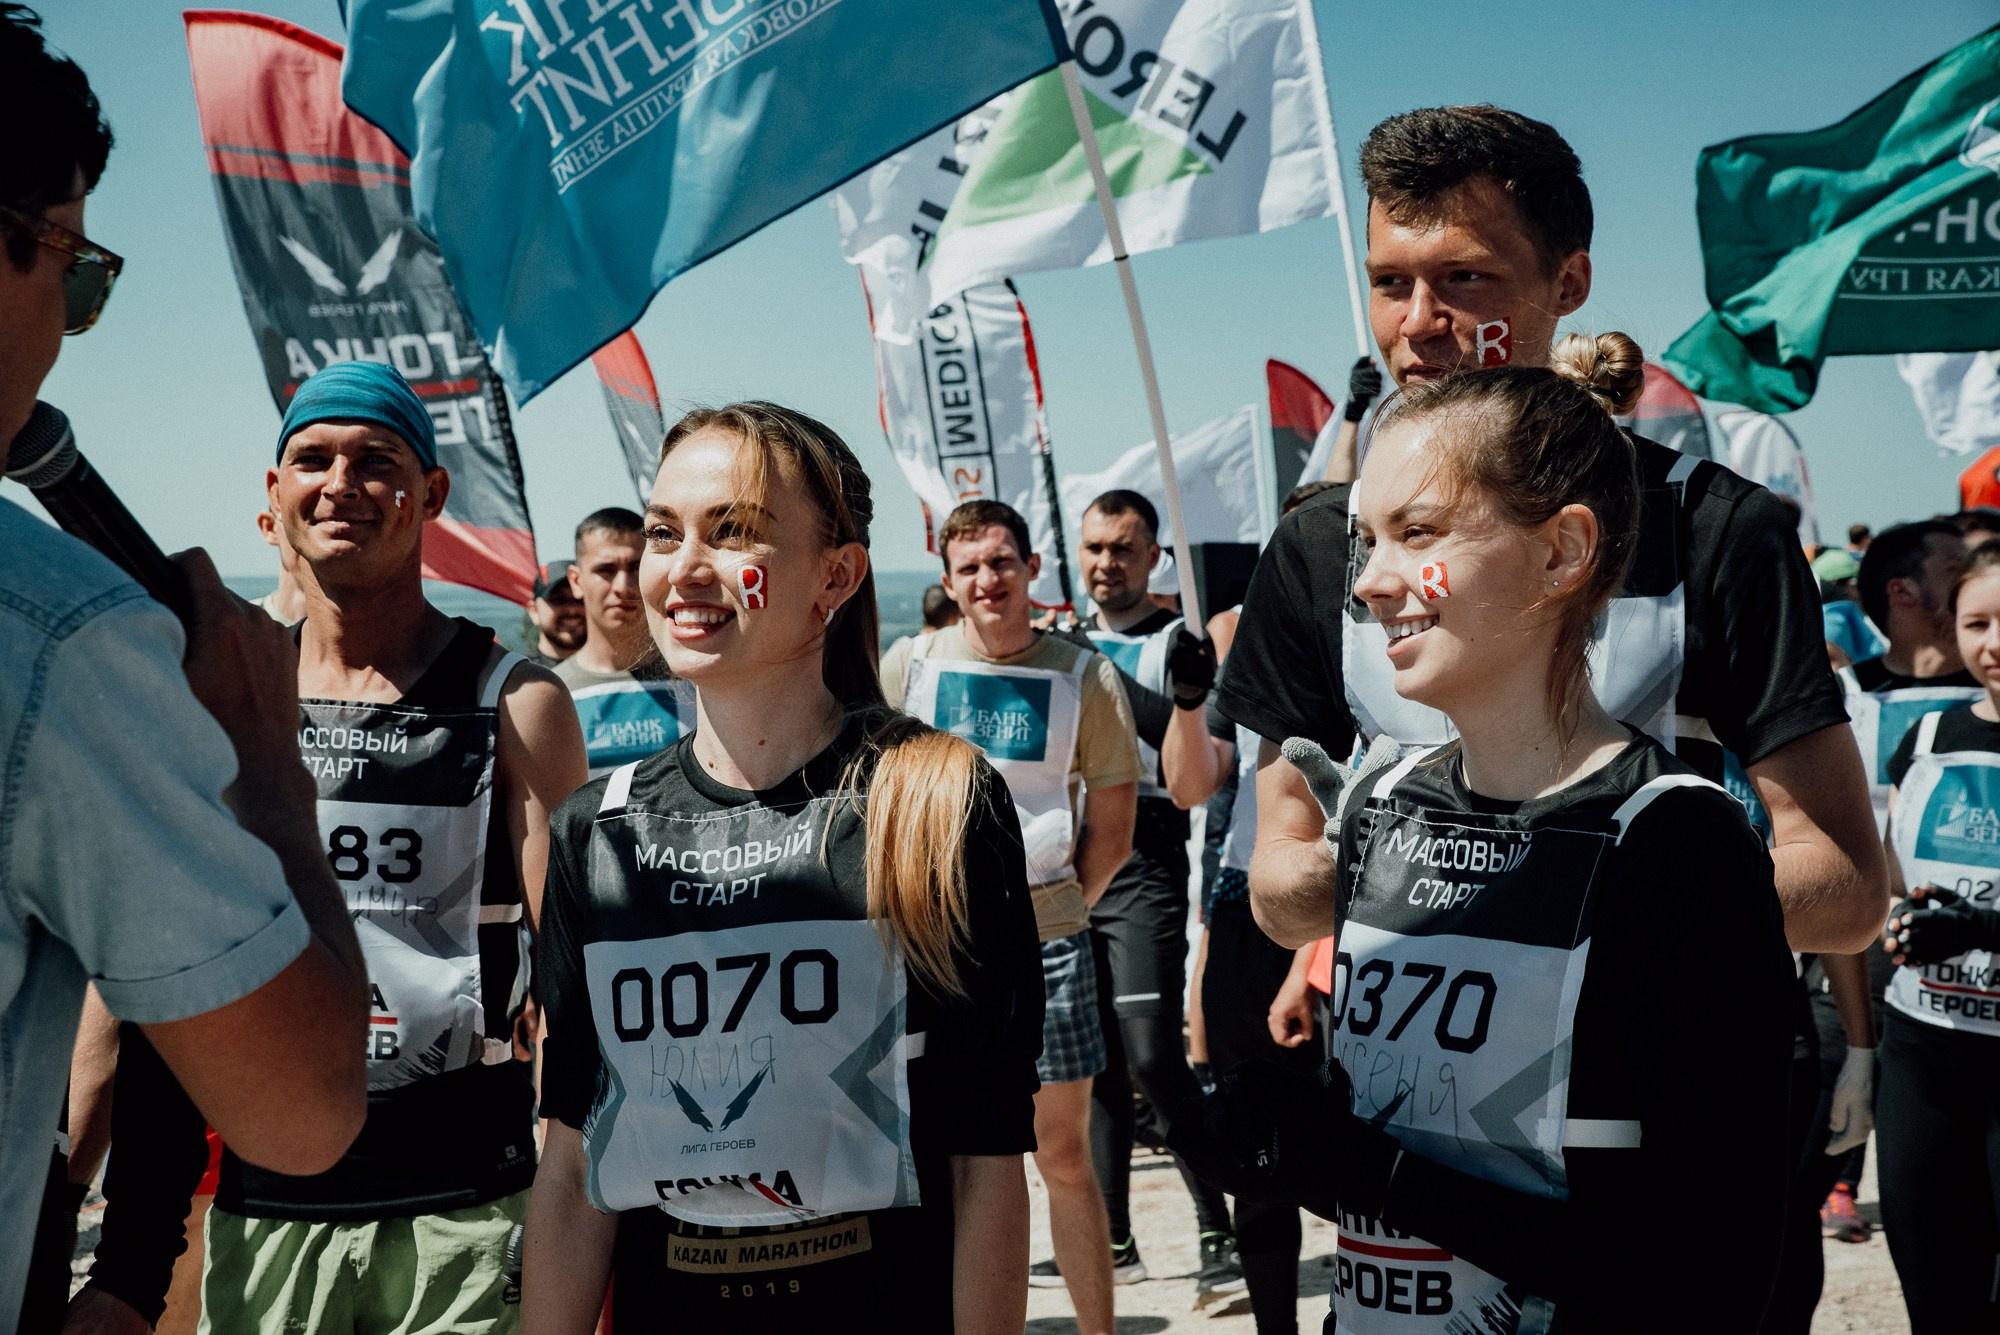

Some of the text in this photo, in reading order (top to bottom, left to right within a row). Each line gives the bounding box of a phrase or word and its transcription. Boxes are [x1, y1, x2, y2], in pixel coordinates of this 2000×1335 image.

[976, 723, 1033, 741] ЗЕНИТ
[977, 709, 1030, 727] БАНК
[298, 727, 408, 754] ССОВЫЙ
[635, 820, 813, 873] МАССОВЫЙ
[1384, 828, 1533, 873] МАССОВЫЙ
[669, 872, 768, 907] СТАРТ
[1408, 877, 1486, 910] СТАРТ
[611, 948, 839, 1044] 0070
[680, 1138, 756, 1155] ЛИГА ГЕРОЕВ
[673, 1228, 859, 1266] KAZAN MARATHON
[720, 1280, 801, 1299] 2019
[1335, 1254, 1454, 1316] РОЕВ
